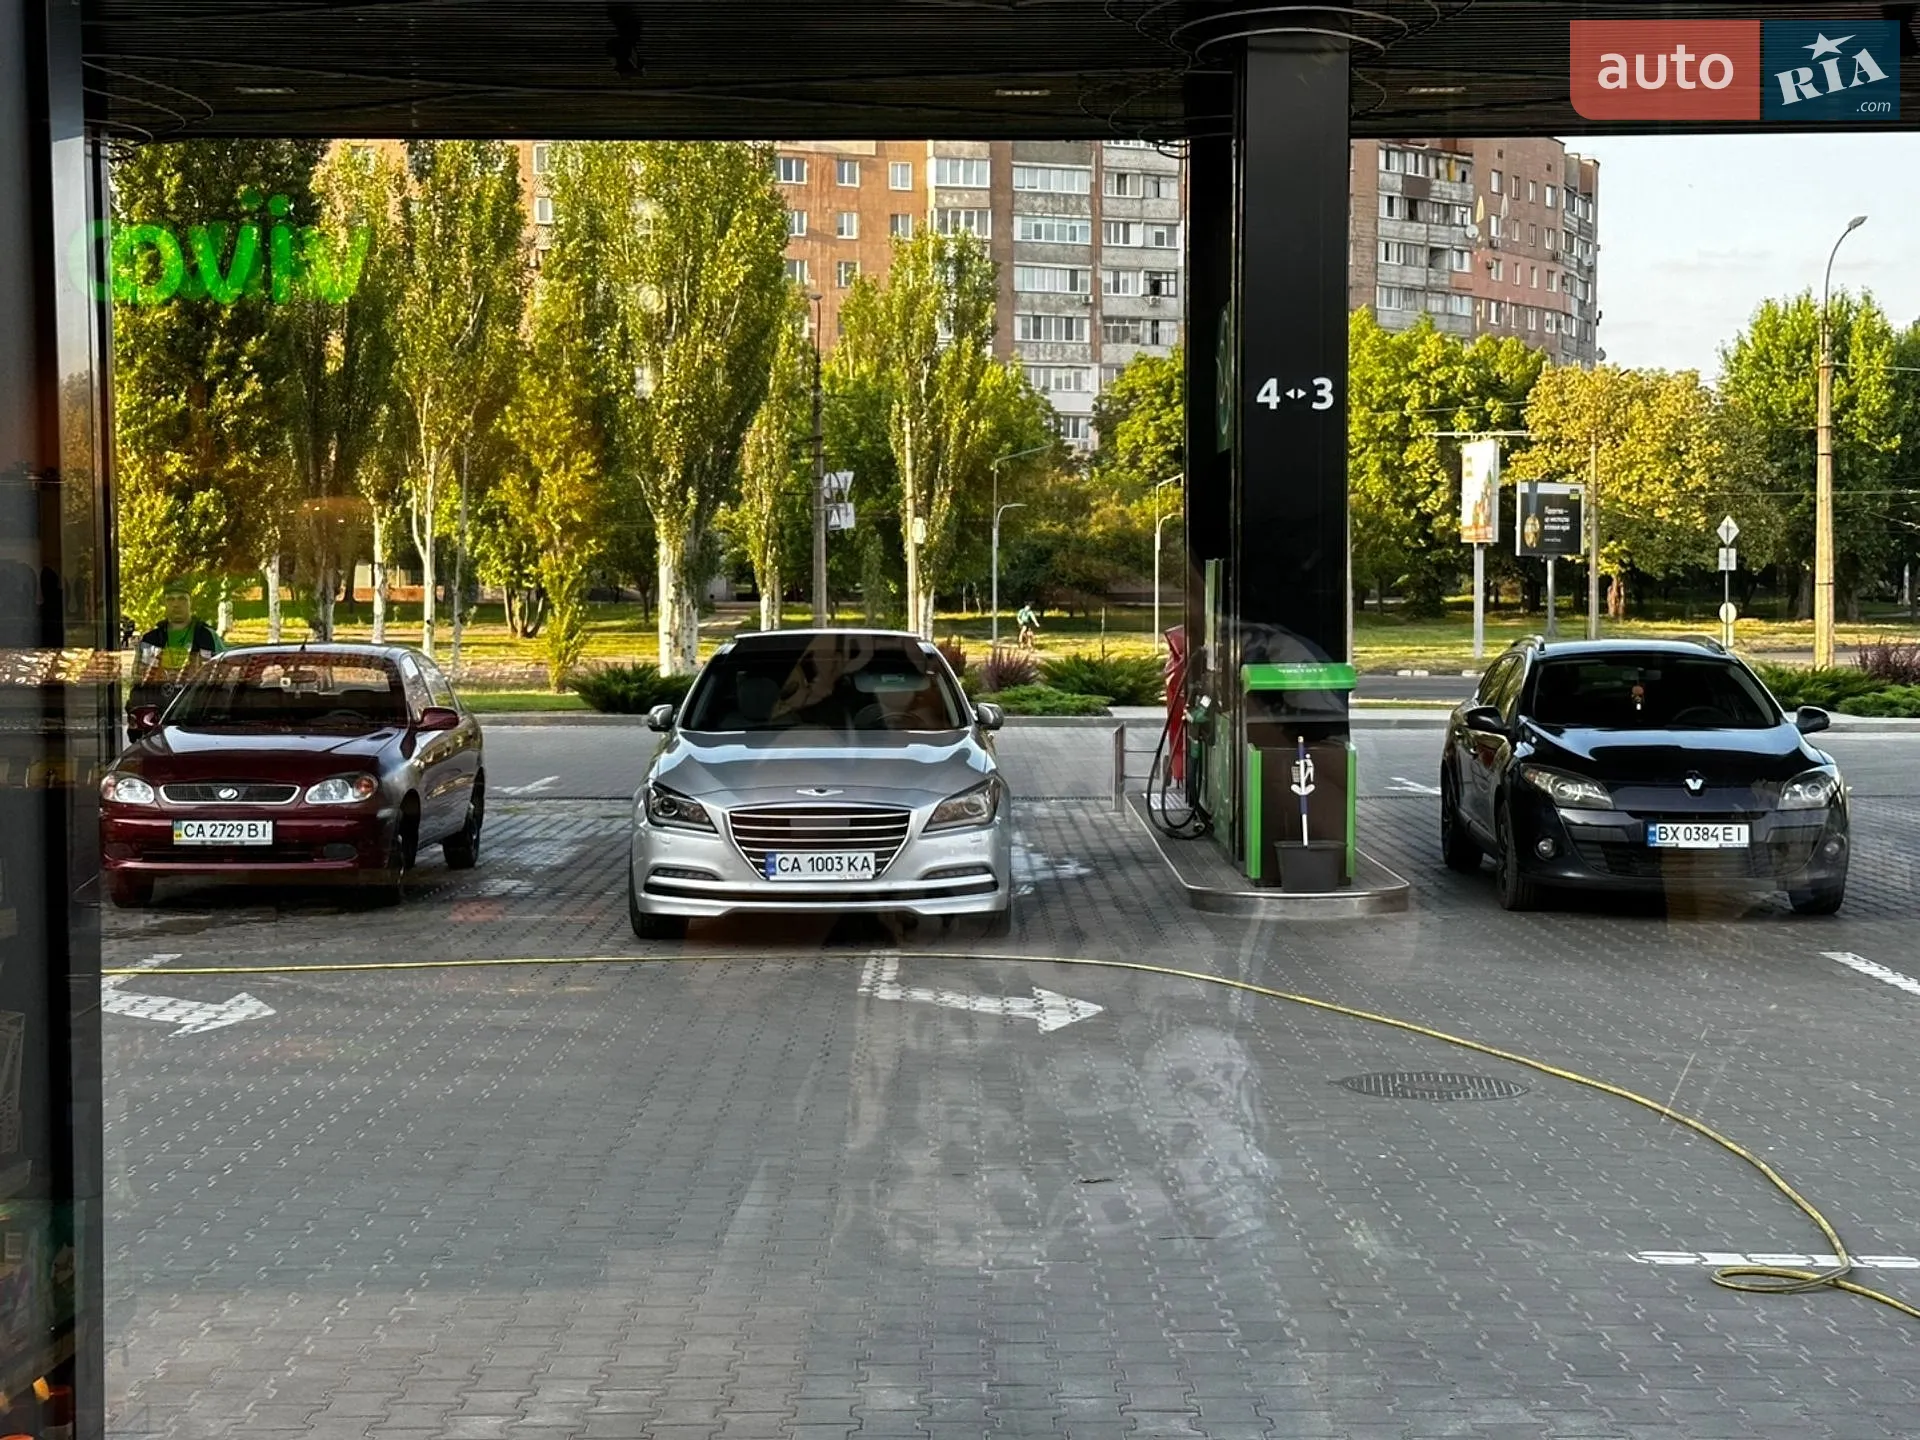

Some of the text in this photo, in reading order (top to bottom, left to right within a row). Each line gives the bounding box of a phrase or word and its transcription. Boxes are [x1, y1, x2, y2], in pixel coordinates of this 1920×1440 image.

[1256, 376, 1334, 410] 4 3
[184, 823, 267, 838] CA 2729 BI
[1658, 826, 1741, 841] BX 0384 EI
[778, 856, 872, 872] CA 1003 KA
